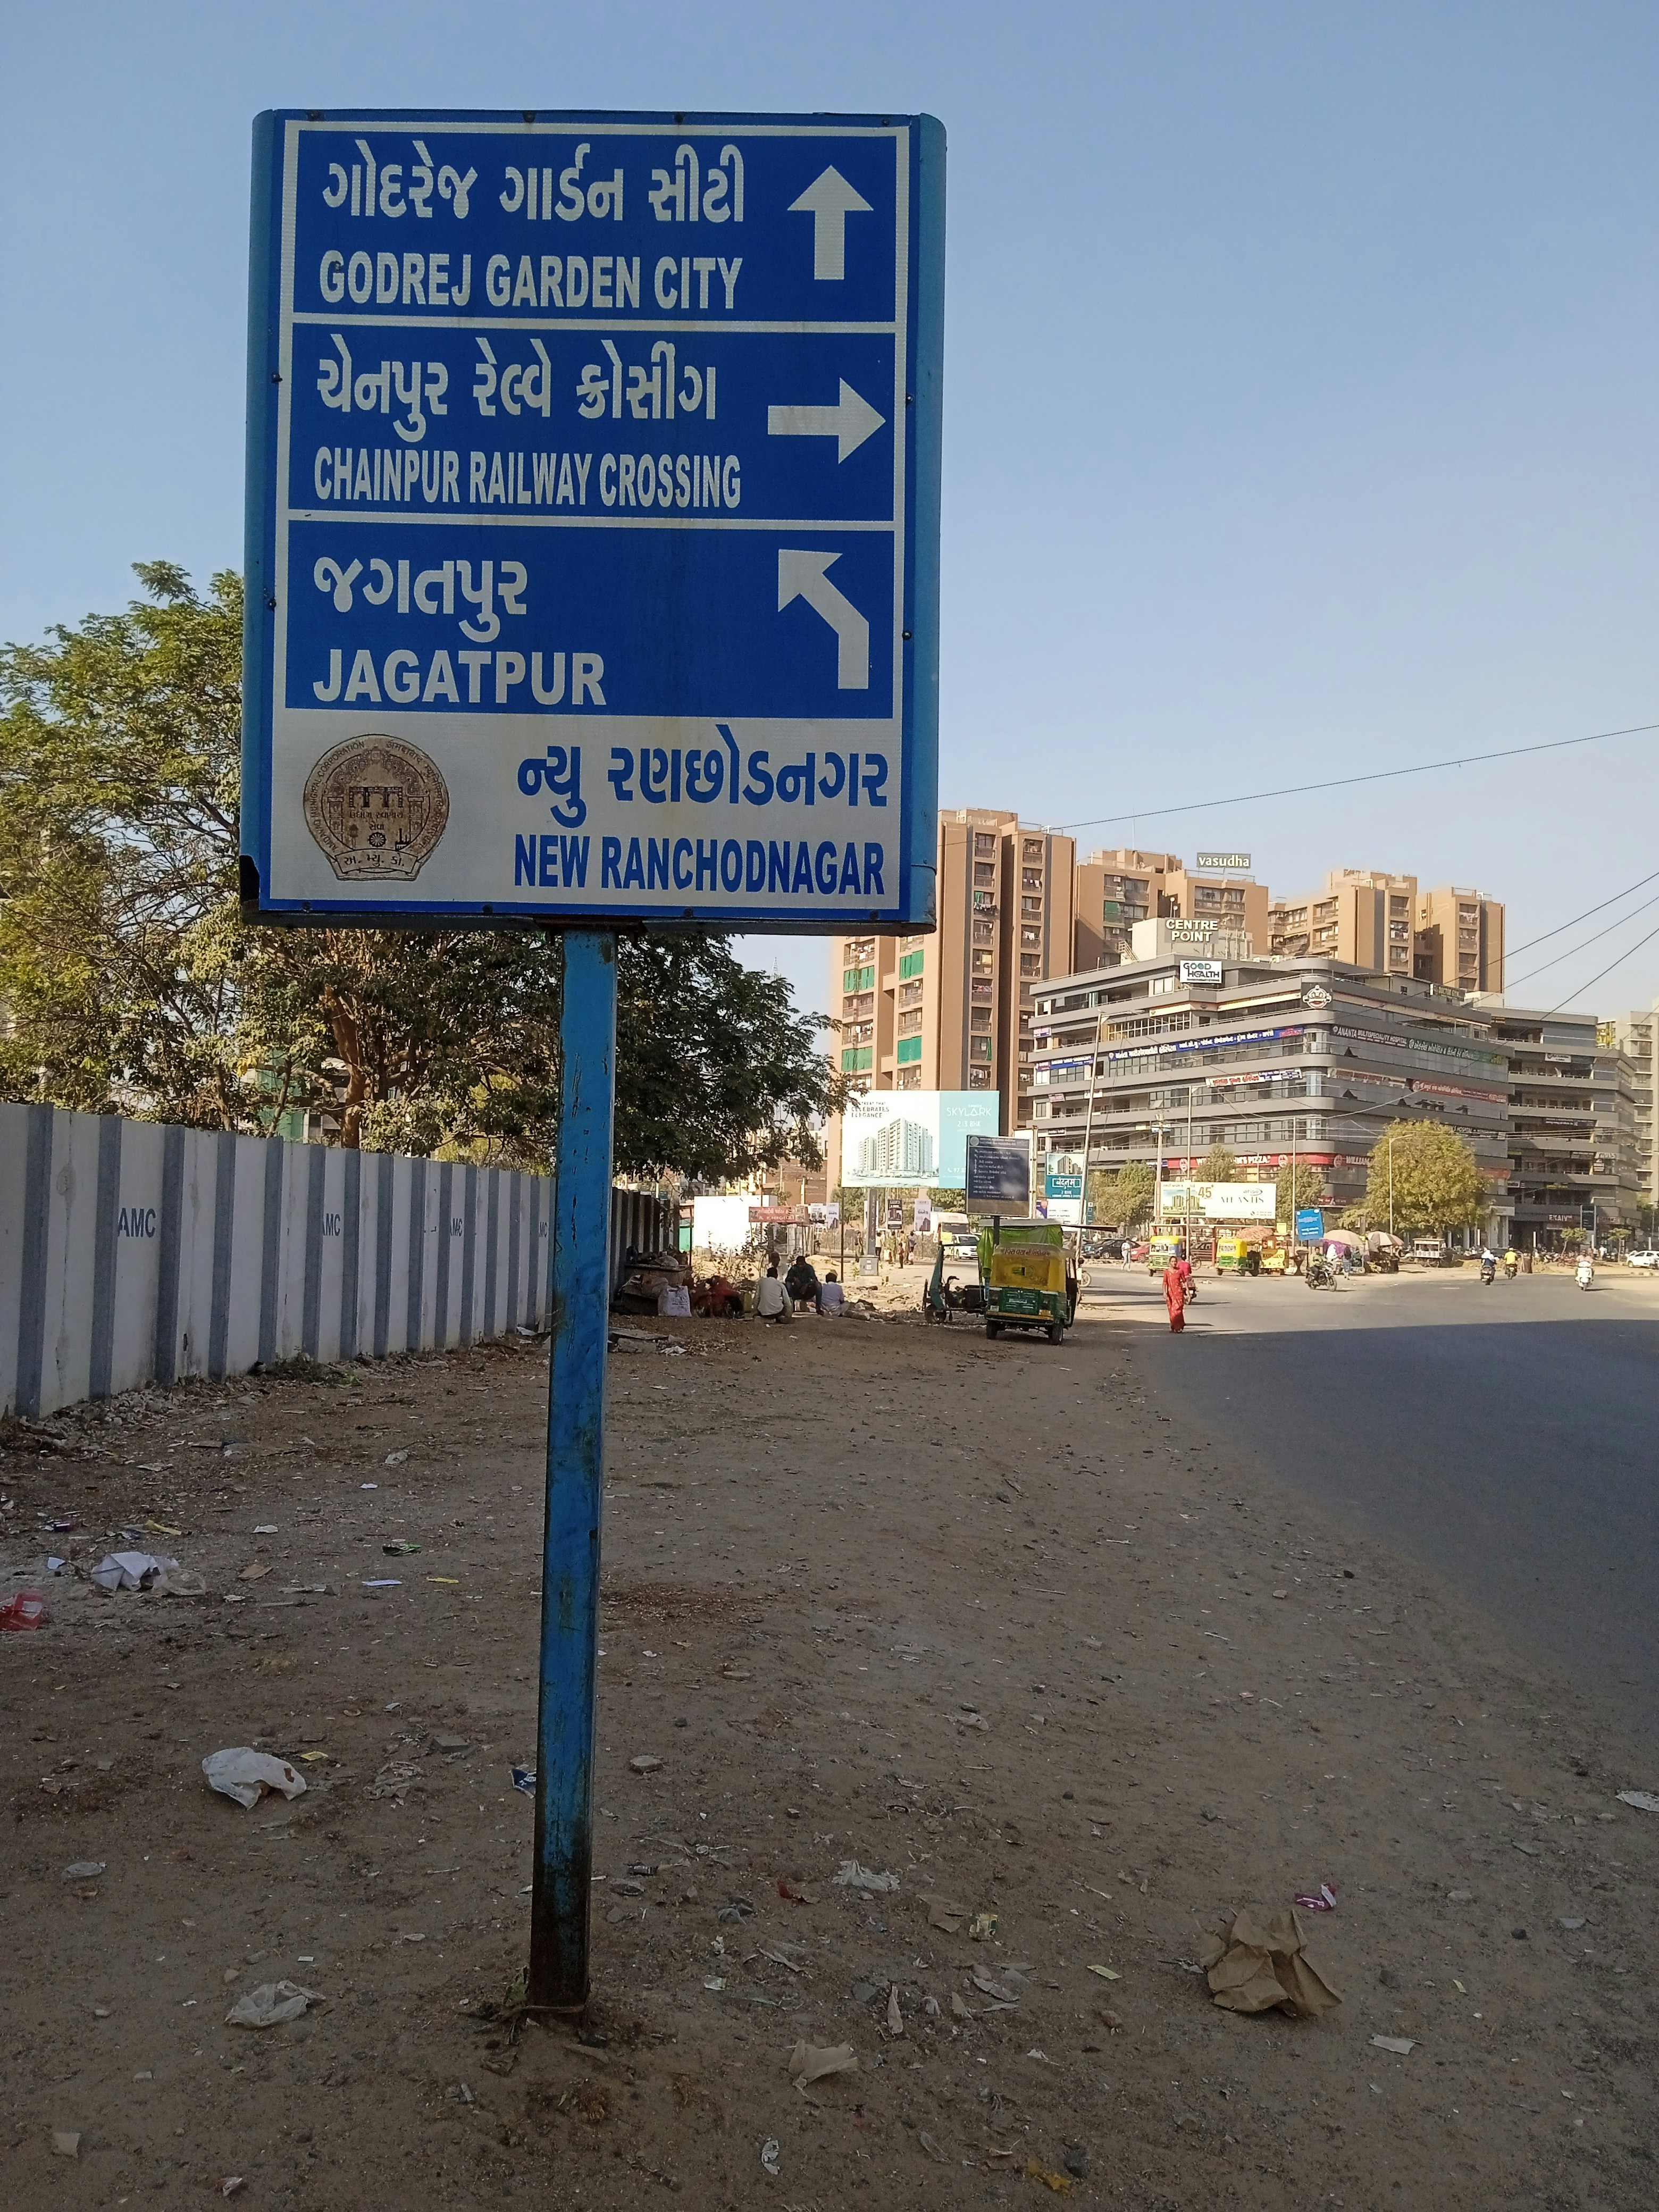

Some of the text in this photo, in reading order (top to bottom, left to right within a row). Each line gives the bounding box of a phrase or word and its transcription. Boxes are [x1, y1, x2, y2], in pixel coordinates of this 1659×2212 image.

[322, 139, 744, 223] ગોદરેજ ગાર્ડન સીટી
[320, 250, 743, 309] GODREJ GARDEN CITY
[317, 334, 448, 442] ચેનપુર
[473, 337, 551, 417] રેલ્વે
[314, 447, 741, 508] CHAINPUR RAILWAY CROSSING
[314, 557, 527, 643] જગતપુર
[313, 649, 606, 705] JAGATPUR
[319, 741, 366, 778] CORPORATION
[517, 724, 889, 829] ન્યુ રણછોડનગર
[514, 834, 885, 895] NEW RANCHODNAGAR
[1198, 854, 1250, 867] vasudha
[1166, 919, 1218, 931] CENTRE
[1171, 930, 1212, 942] POINT
[1187, 970, 1220, 978] HEALTH
[1337, 1027, 1357, 1038] ANANTA
[1358, 1029, 1390, 1041] MULTISPECIALITY
[946, 1107, 992, 1117] SKYLARK
[118, 1207, 156, 1238] AMC
